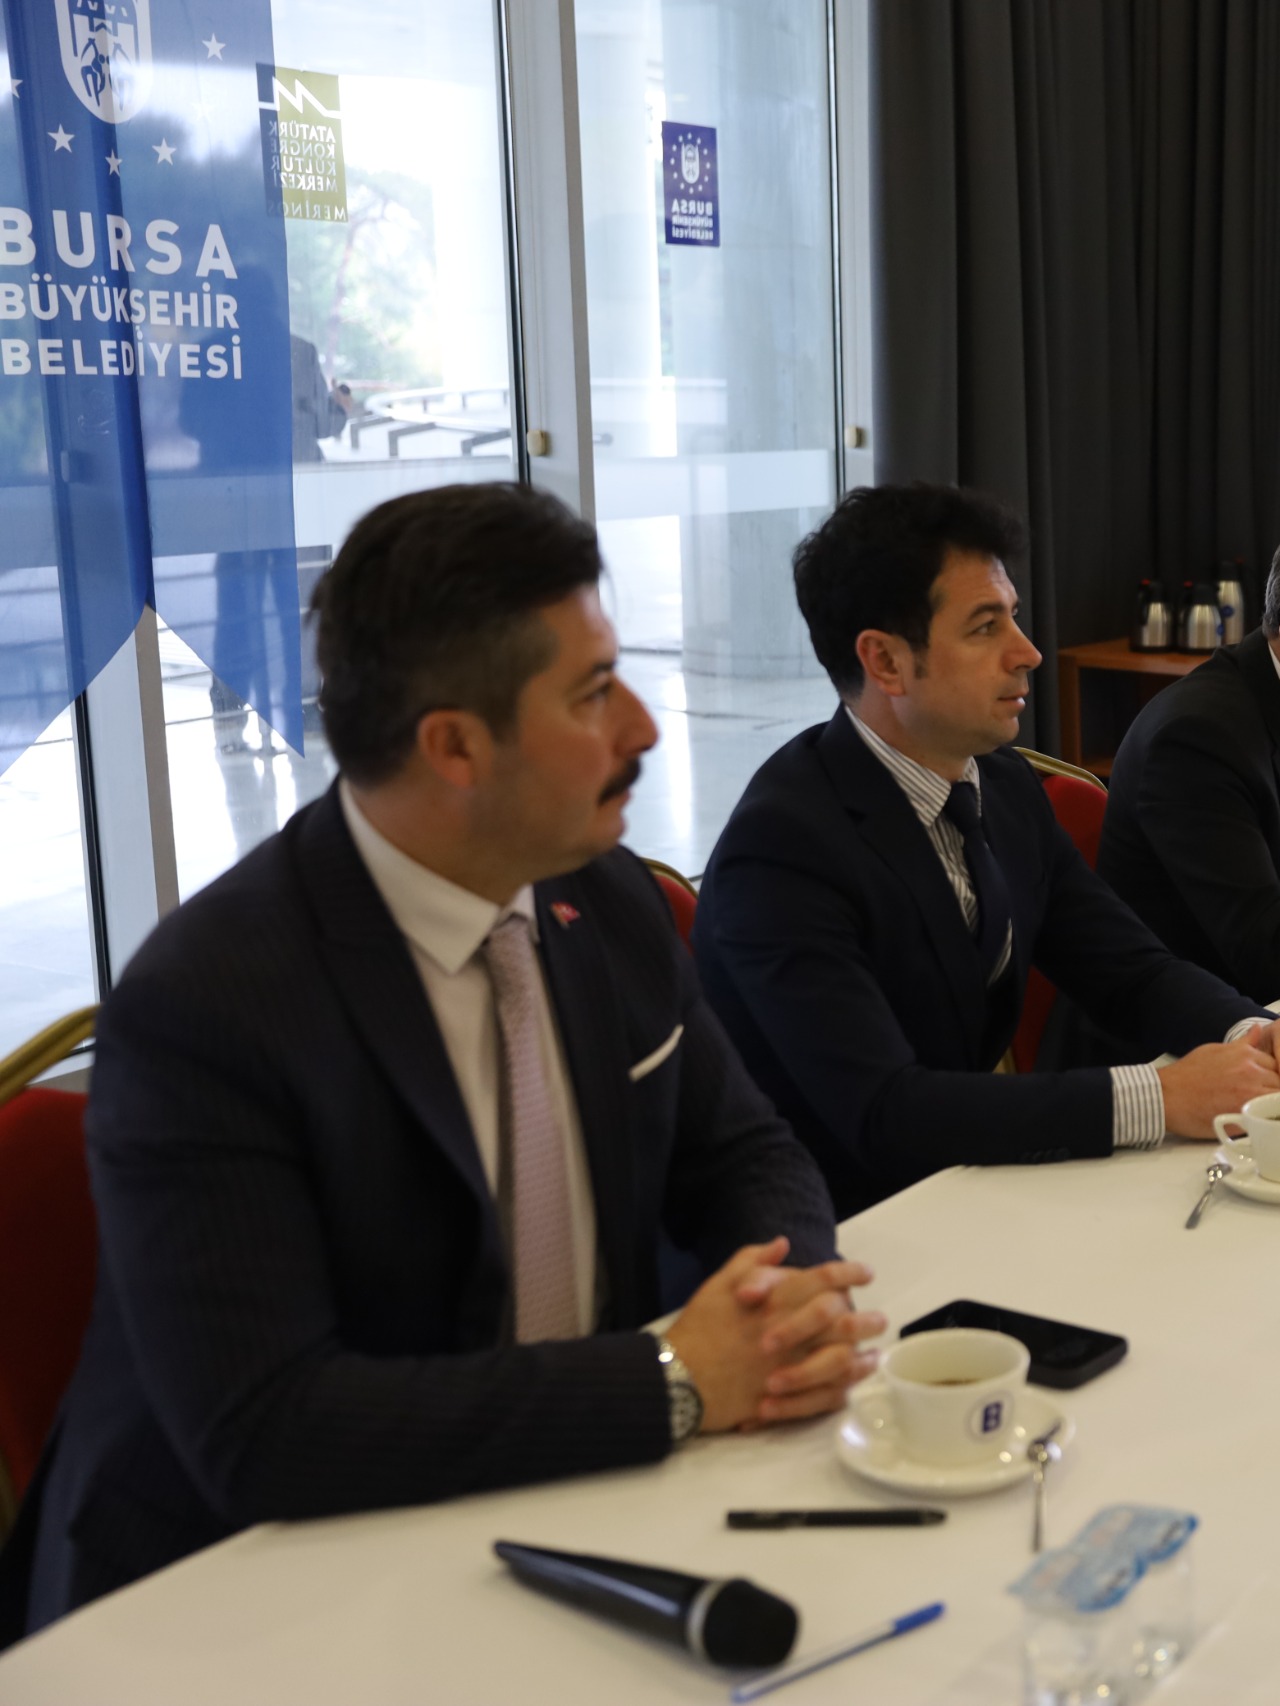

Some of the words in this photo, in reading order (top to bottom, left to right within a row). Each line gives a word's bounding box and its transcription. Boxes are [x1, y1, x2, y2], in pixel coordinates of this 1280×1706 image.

[0, 206, 238, 279] BURSA
[1, 330, 242, 380] BELEDİYESİ
[982, 1400, 1004, 1434] B
